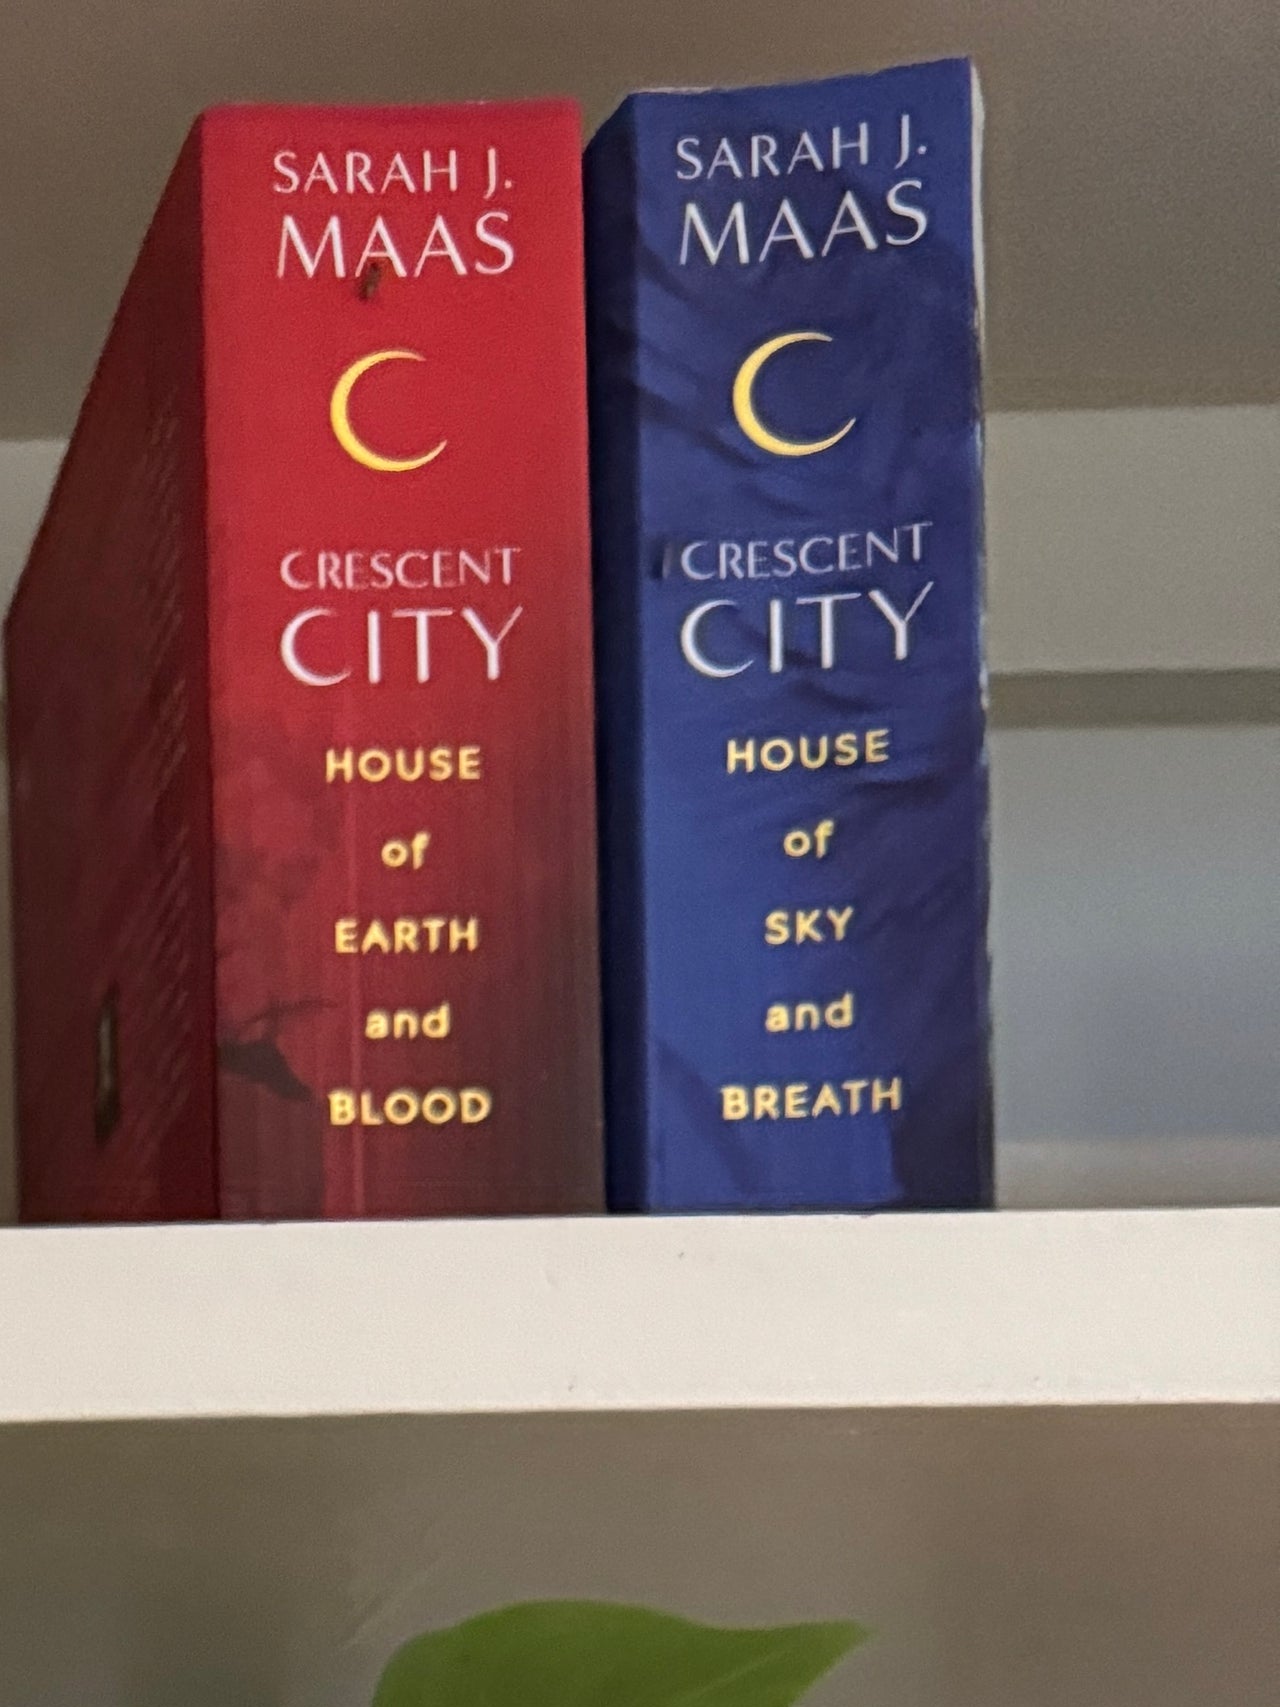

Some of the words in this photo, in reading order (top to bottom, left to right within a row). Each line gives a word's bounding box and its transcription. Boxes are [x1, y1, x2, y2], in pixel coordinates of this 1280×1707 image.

[675, 121, 869, 181] SARAH
[893, 113, 928, 171] J.
[272, 149, 458, 195] SARAH
[482, 146, 514, 200] J.
[678, 178, 928, 266] MAAS
[276, 210, 516, 280] MAAS
[279, 546, 523, 590] CRESCENT
[680, 521, 934, 581] CRESCENT
[279, 603, 525, 687] CITY
[680, 581, 935, 679] CITY
[324, 744, 482, 783] HOUSE
[725, 727, 891, 775] HOUSE
[380, 830, 432, 870] of
[782, 818, 836, 859] of
[333, 915, 480, 955] EARTH
[763, 905, 854, 946] SKY
[363, 1000, 452, 1040] and
[764, 990, 855, 1033] and
[328, 1086, 492, 1126] BLOOD
[719, 1076, 903, 1122] BREATH
